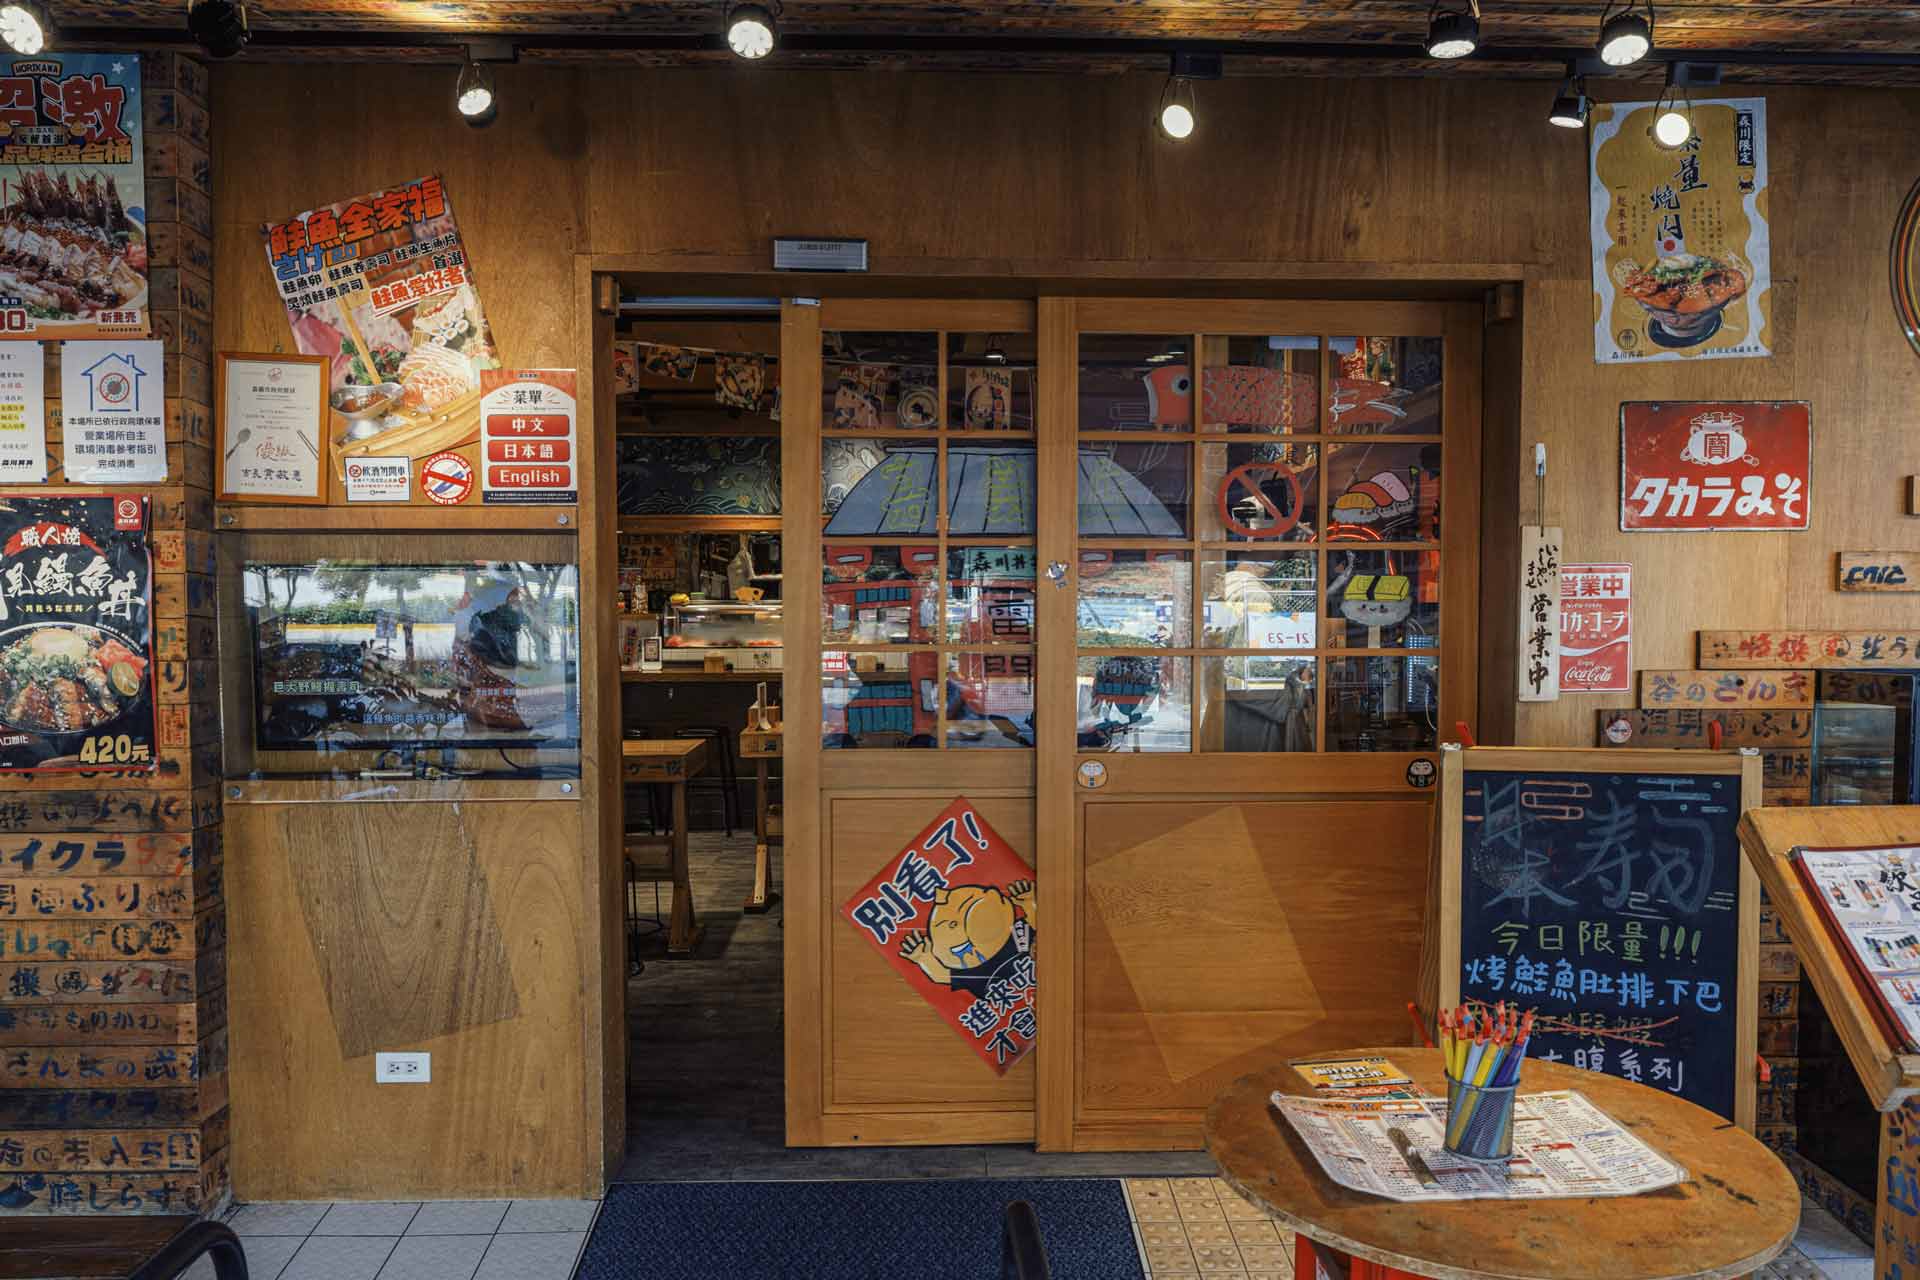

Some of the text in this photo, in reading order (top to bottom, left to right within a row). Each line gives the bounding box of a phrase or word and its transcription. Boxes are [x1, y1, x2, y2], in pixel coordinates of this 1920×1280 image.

[270, 176, 445, 260] 鮭魚全家福
[432, 250, 465, 270] 首選
[282, 274, 322, 294] 鮭魚卵
[513, 389, 543, 404] 菜單
[512, 418, 545, 432] 中文
[504, 444, 554, 458] 日本語
[362, 466, 405, 477] 飲酒勿開車
[500, 470, 560, 485] English
[1630, 472, 1802, 519] タカラみそ
[1564, 665, 1612, 682] Coca-Cola
[80, 733, 150, 764] 420元
[11, 838, 126, 872] イクラ
[852, 811, 989, 944] 別看了!
[1492, 920, 1702, 963] 今日限量!!!
